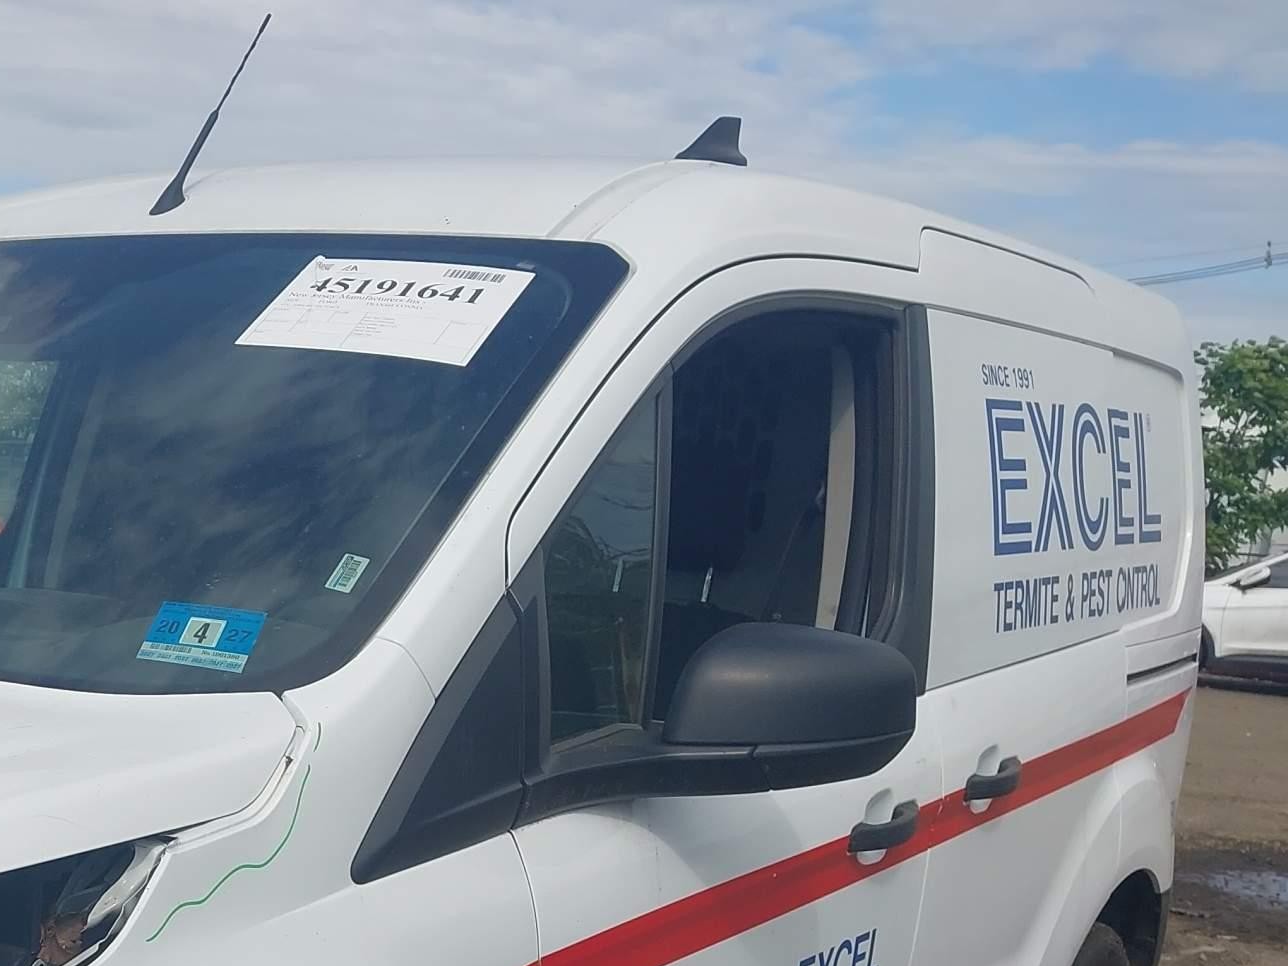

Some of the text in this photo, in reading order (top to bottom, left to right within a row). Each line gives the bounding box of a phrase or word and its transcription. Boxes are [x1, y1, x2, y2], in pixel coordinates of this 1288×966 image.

[309, 276, 485, 305] 45191641
[981, 363, 1036, 390] SINCE 1991
[985, 398, 1162, 557] EXCEL
[993, 575, 1061, 633] TERMITE
[1065, 573, 1075, 623] &
[1080, 569, 1113, 620] PEST
[157, 619, 254, 644] 20 4 27
